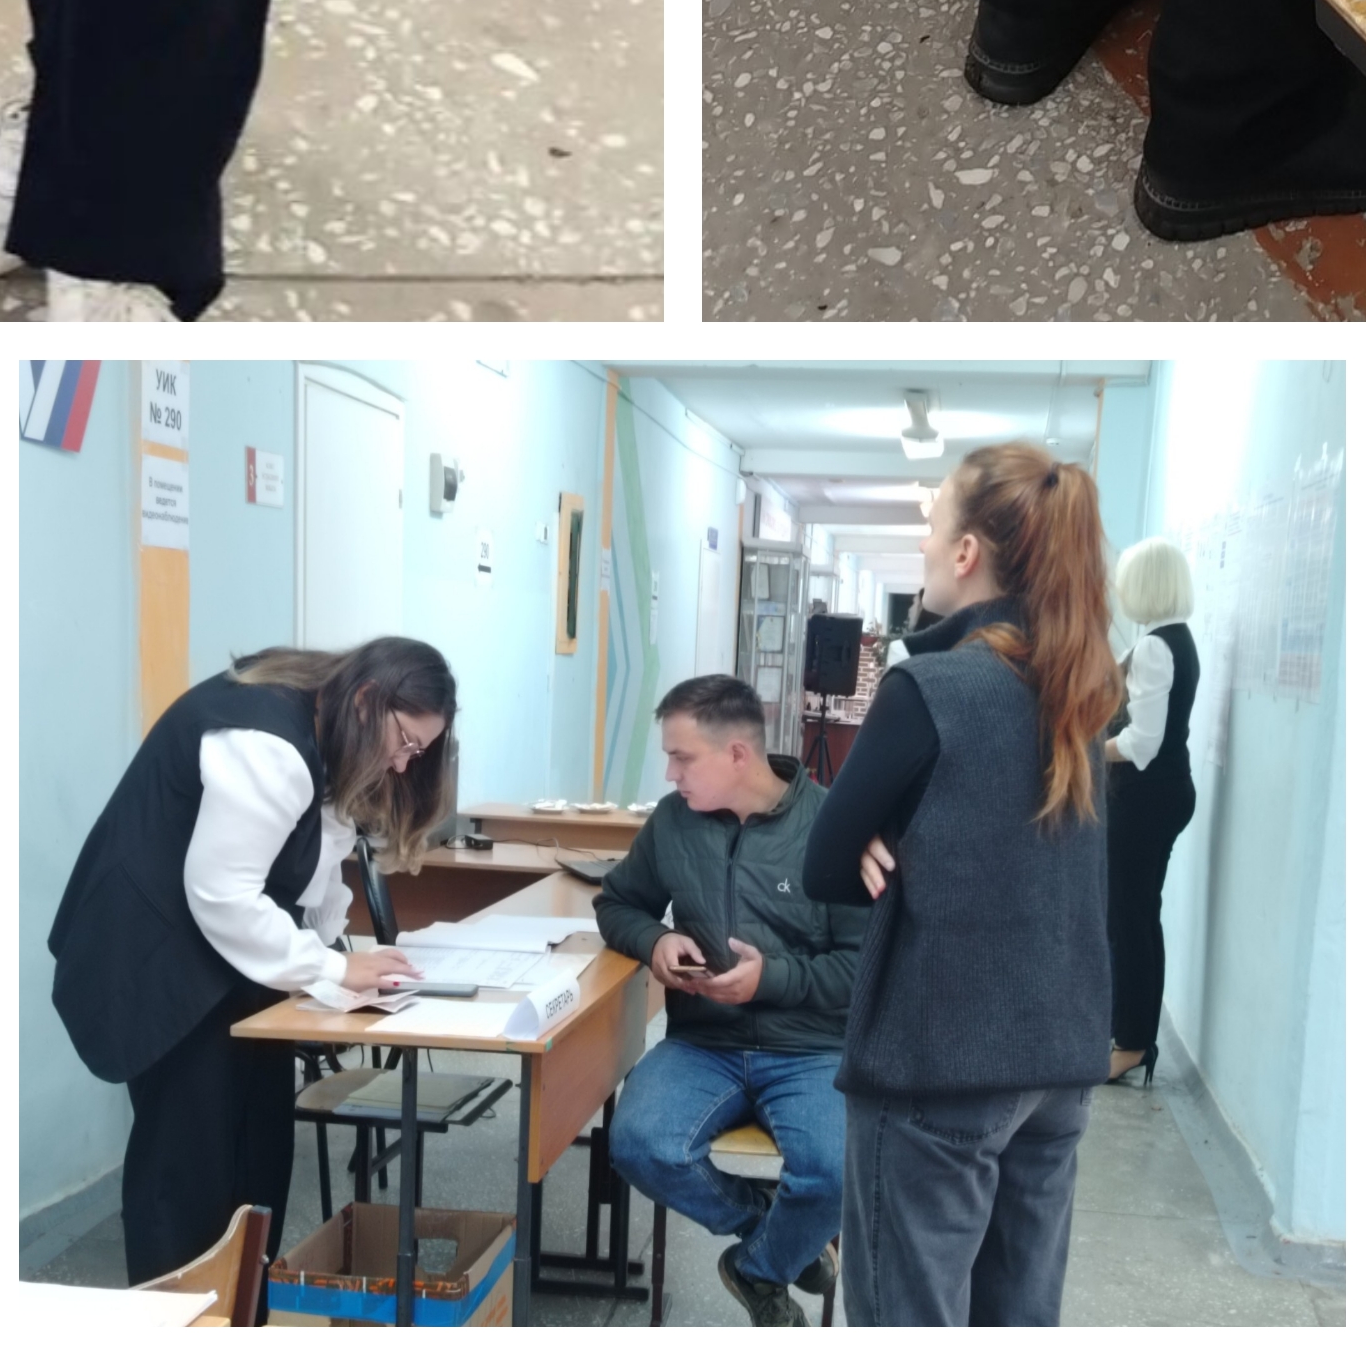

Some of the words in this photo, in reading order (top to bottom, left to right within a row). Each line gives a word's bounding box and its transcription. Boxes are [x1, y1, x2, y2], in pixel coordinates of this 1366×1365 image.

[156, 369, 177, 396] УИК
[150, 401, 161, 424] №
[165, 406, 182, 431] 290
[148, 476, 153, 487] В
[154, 478, 183, 494] помещении
[248, 464, 254, 486] 3
[155, 496, 177, 508] ведется
[545, 989, 574, 1020] СЕКРЕТАРЬ
